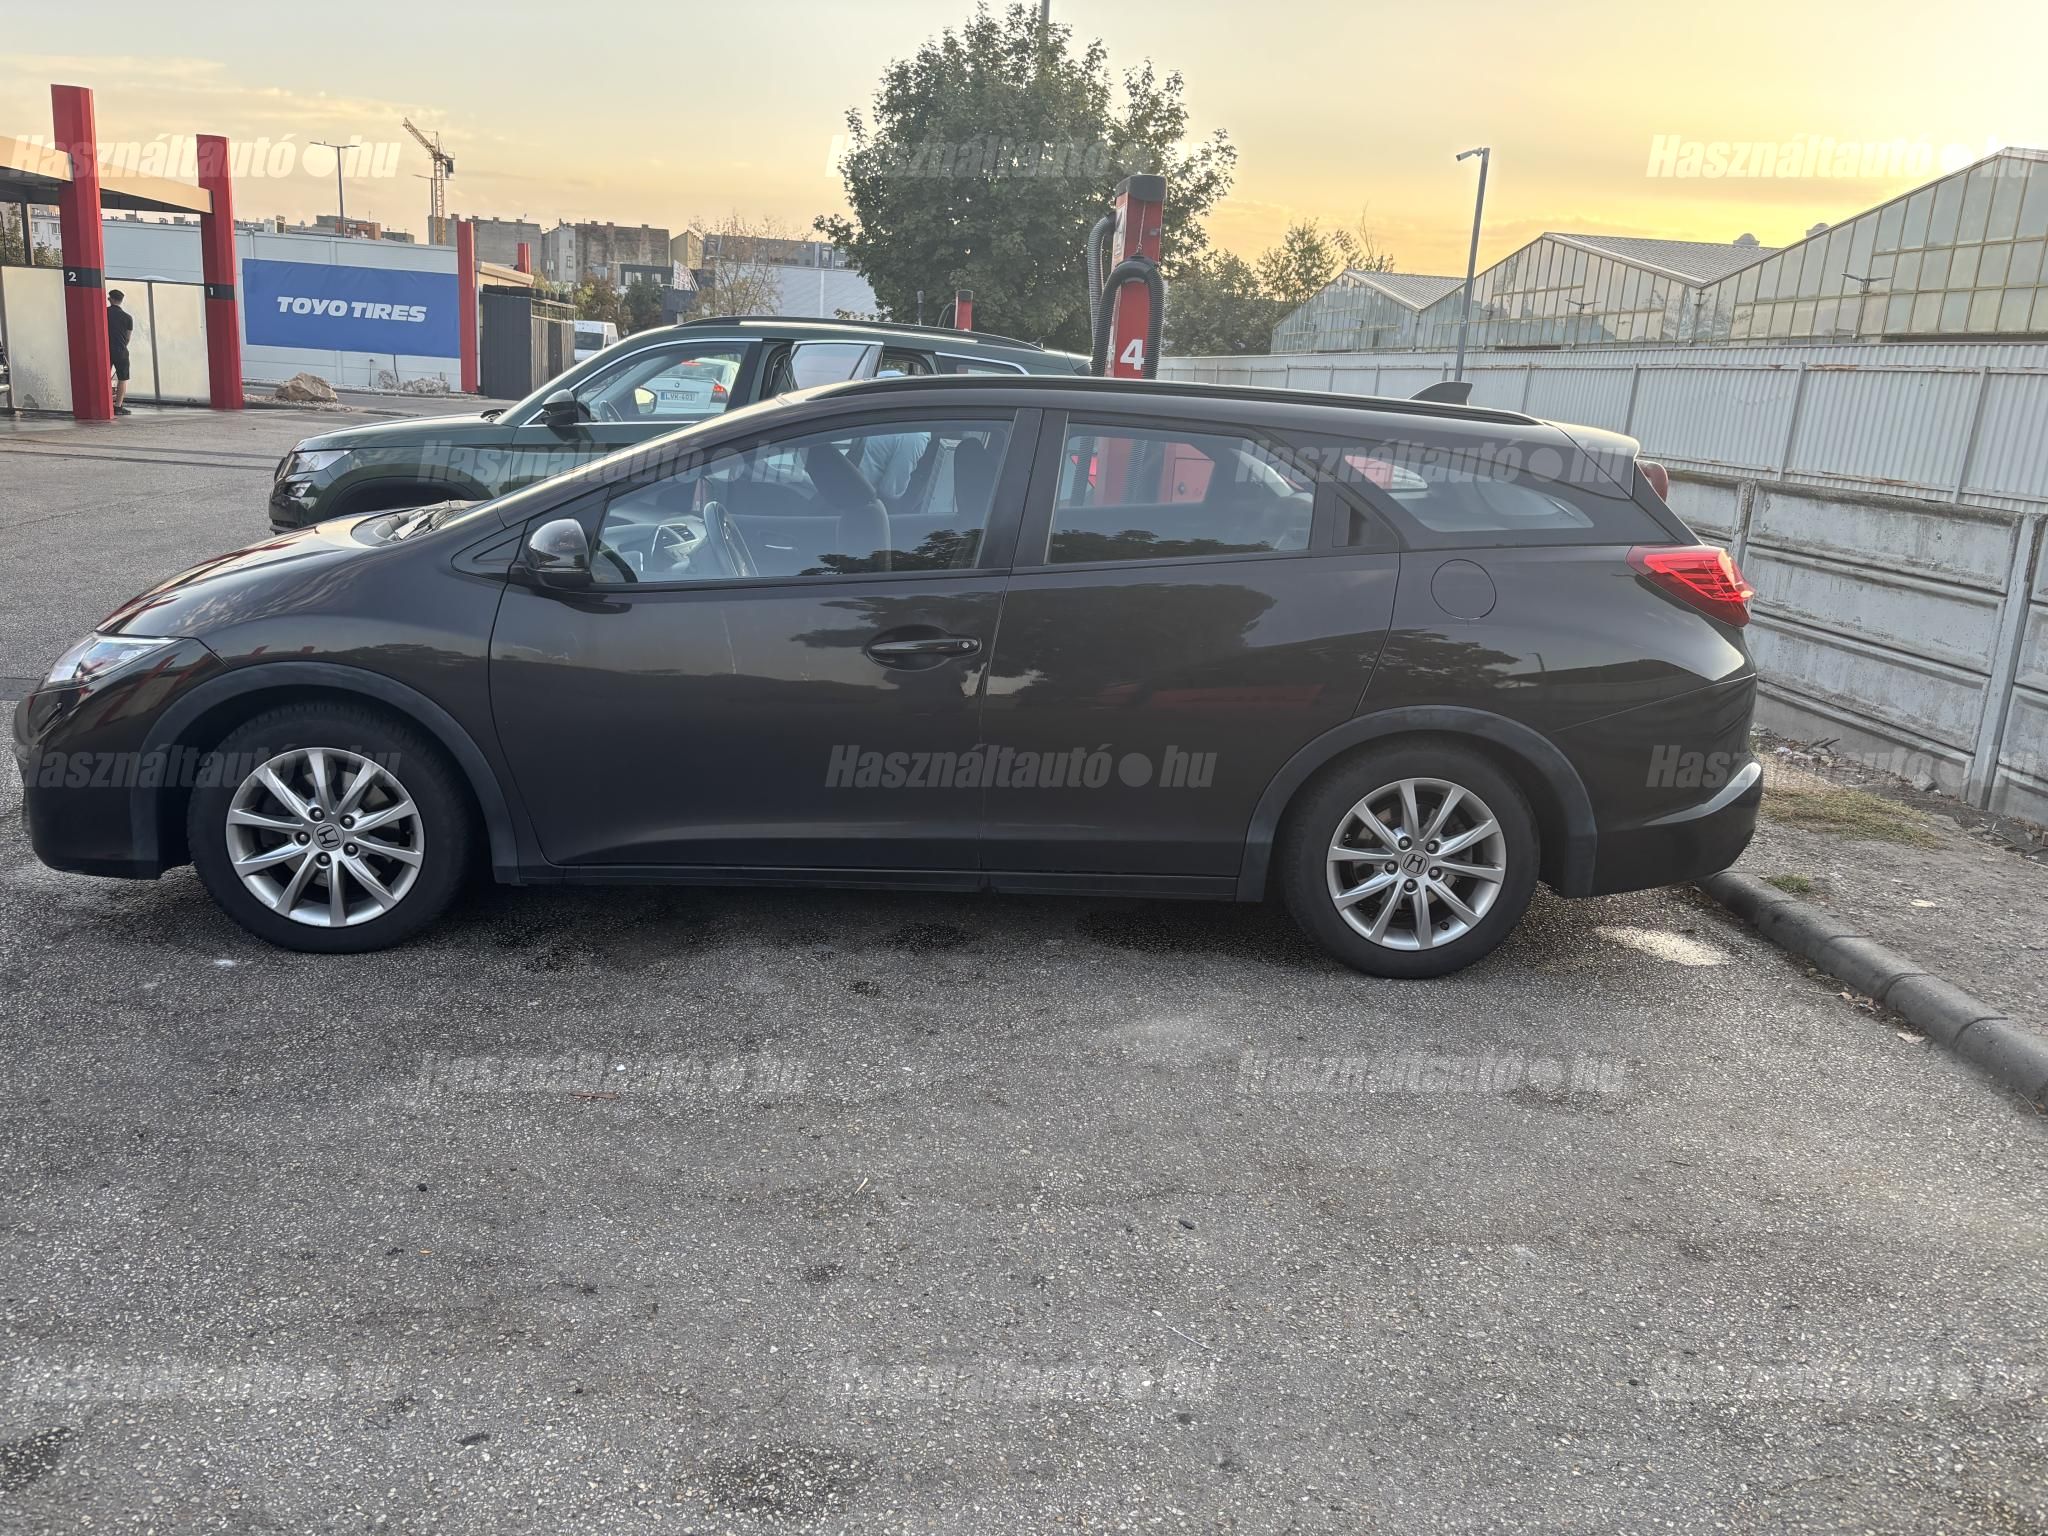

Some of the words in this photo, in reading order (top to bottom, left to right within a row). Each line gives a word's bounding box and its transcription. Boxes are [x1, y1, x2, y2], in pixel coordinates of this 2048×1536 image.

[68, 271, 77, 282] 2
[209, 287, 214, 296] 1
[277, 296, 348, 317] TOYO
[351, 301, 427, 323] TIRES
[1119, 338, 1145, 371] 4
